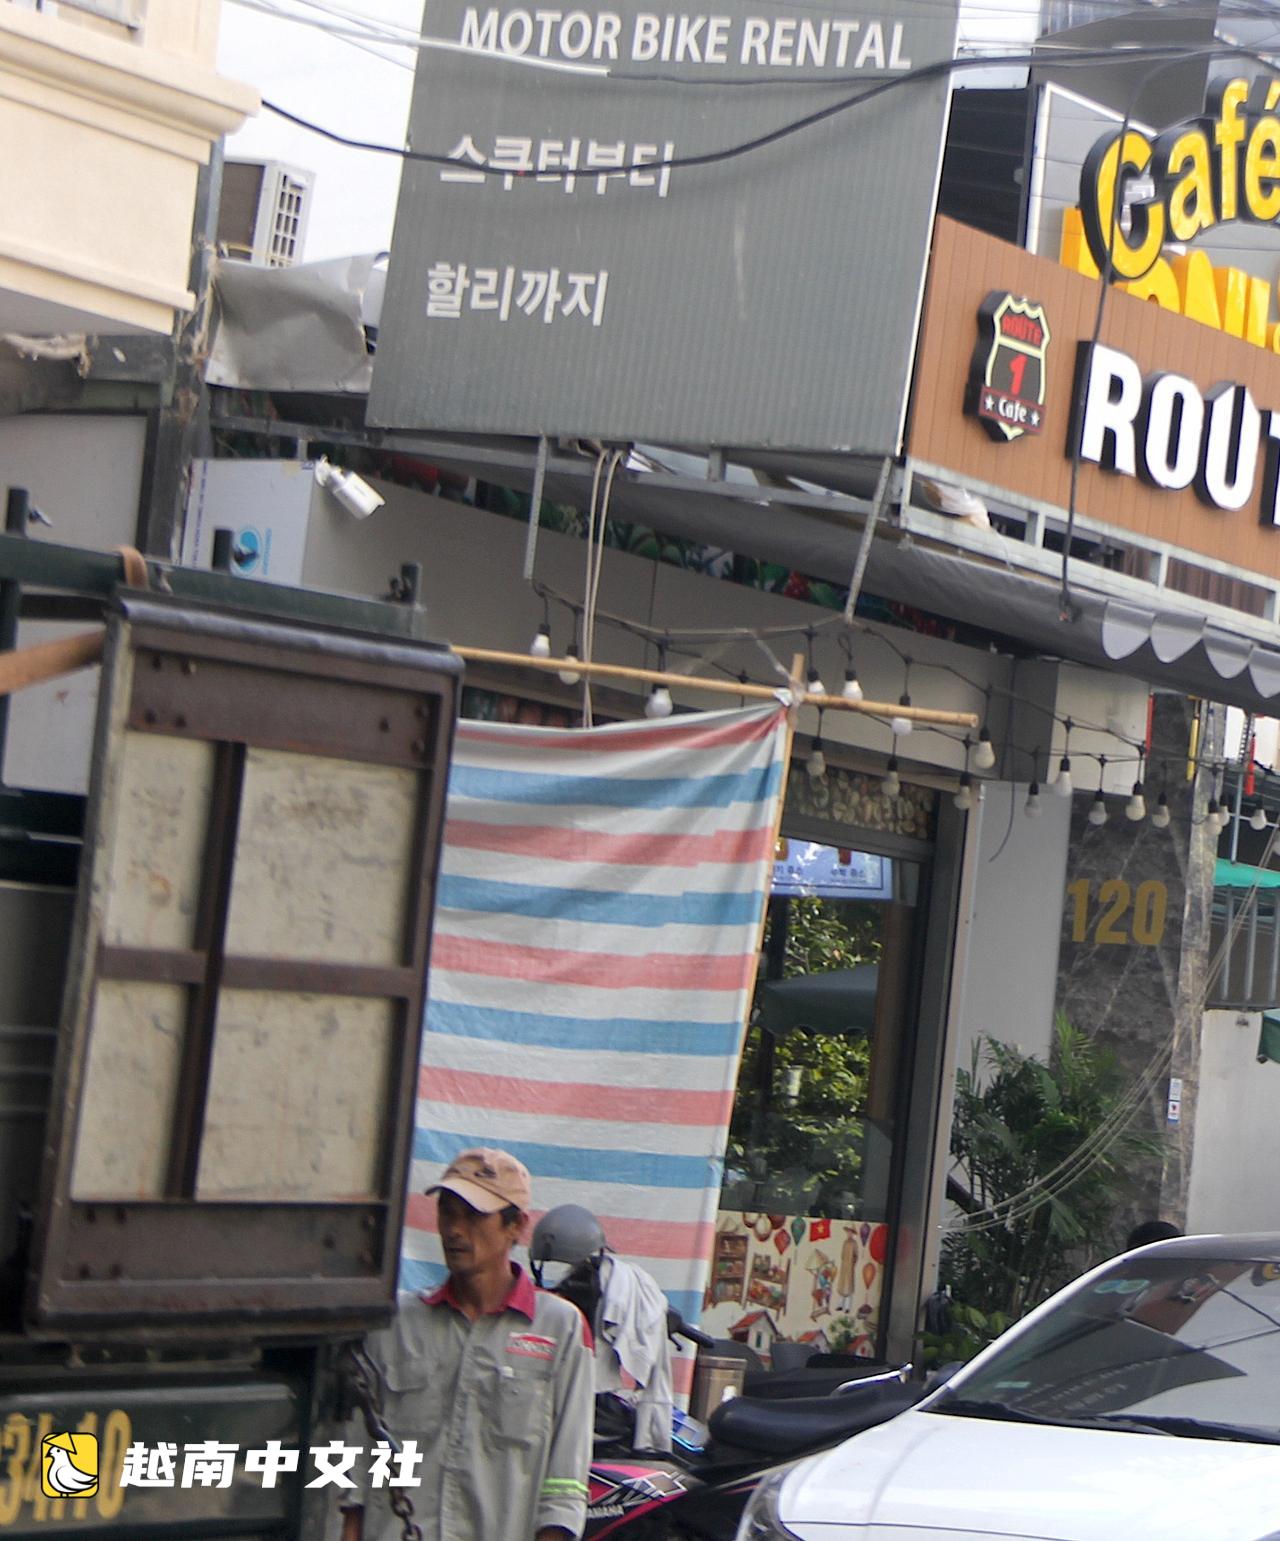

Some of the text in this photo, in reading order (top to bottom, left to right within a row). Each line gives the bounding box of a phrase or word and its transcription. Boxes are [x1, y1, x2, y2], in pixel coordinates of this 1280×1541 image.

[460, 8, 912, 70] MOTOR BIKE RENTAL
[426, 262, 609, 326] 할리까지
[1003, 314, 1043, 346] ROUTE
[1009, 353, 1028, 395] 1
[1067, 879, 1169, 946] 120
